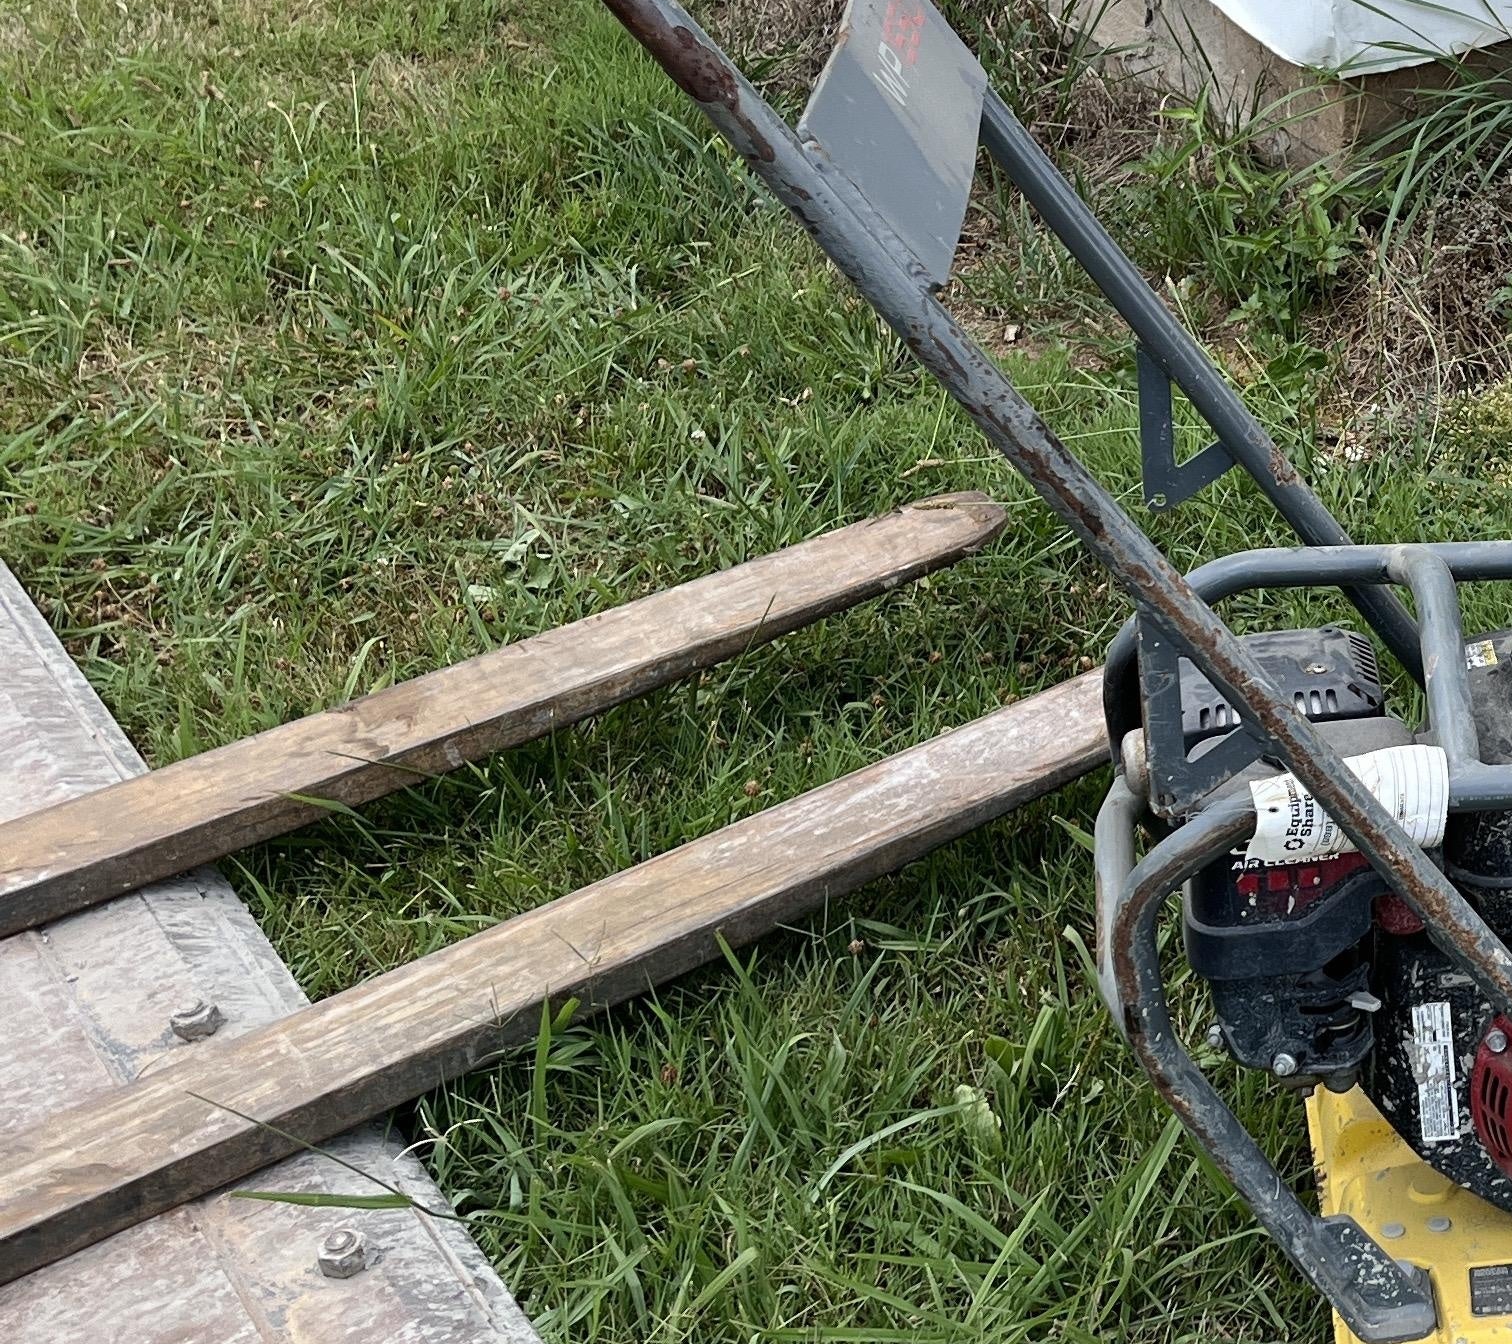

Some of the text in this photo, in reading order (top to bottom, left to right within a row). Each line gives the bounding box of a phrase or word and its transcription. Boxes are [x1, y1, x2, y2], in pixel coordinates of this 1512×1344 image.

[872, 40, 911, 106] WP
[1300, 793, 1314, 837] Share
[1231, 859, 1261, 871] AIR
